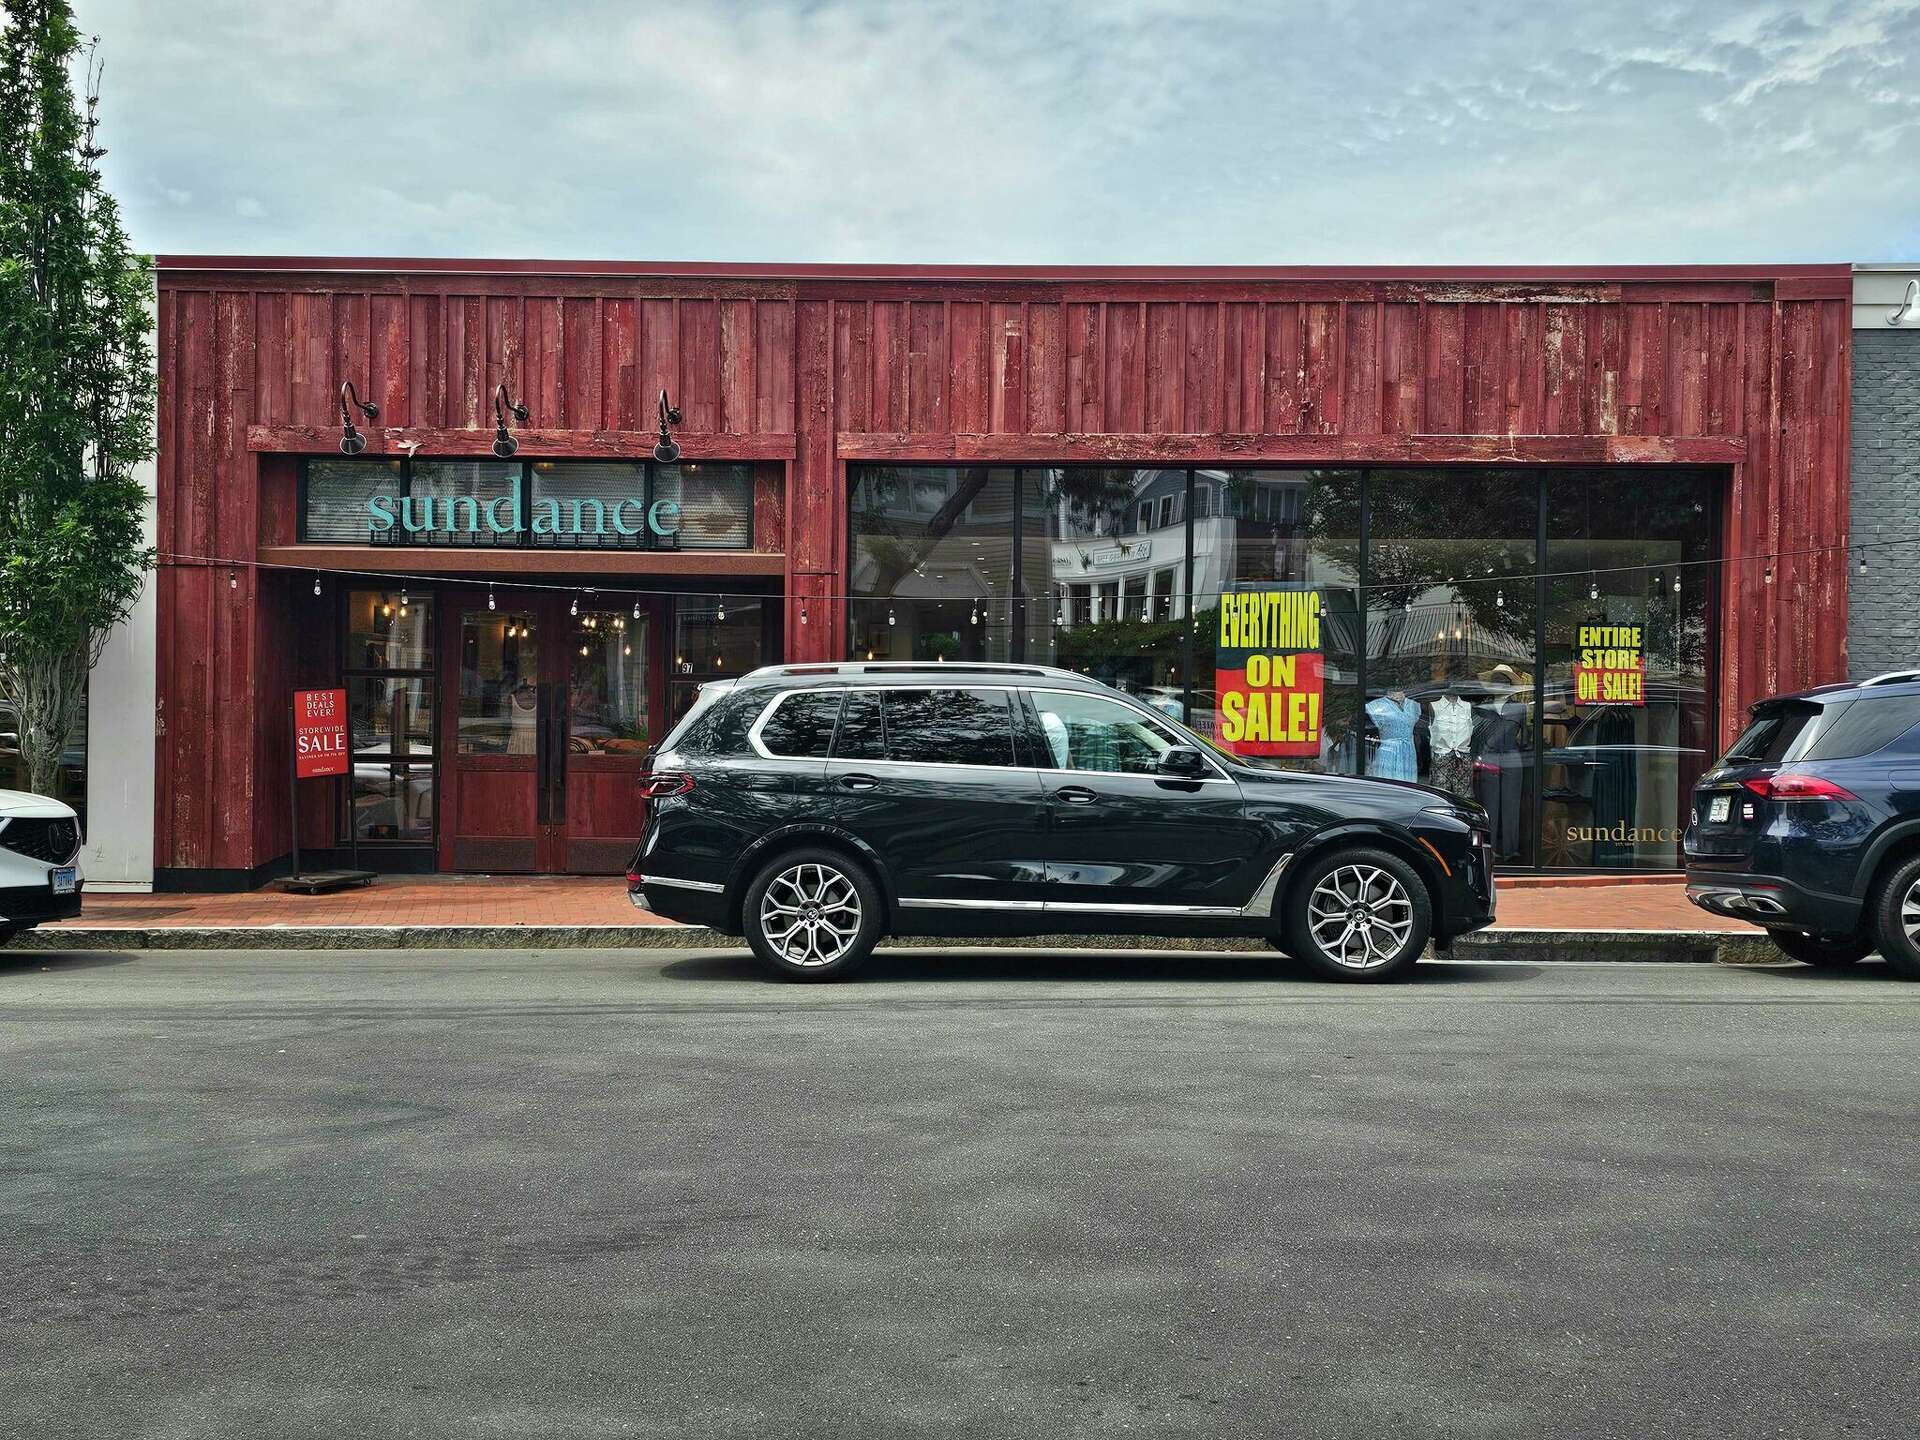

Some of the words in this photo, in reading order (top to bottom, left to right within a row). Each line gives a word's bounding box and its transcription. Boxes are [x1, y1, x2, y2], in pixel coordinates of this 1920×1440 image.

[367, 476, 680, 536] sundance
[1220, 591, 1320, 649] EVERYTHING
[1579, 626, 1642, 647] ENTIRE
[682, 662, 693, 674] 97
[1581, 649, 1640, 670] STORE
[1246, 654, 1296, 688] ON
[1578, 672, 1598, 700] ON
[1603, 672, 1642, 700] SALE!
[306, 693, 334, 701] BEST
[306, 701, 334, 709] DEALS
[307, 709, 334, 717] EVER!
[1221, 690, 1320, 742] SALE!
[299, 725, 344, 734] STOREWIDE
[298, 733, 346, 753] SALE
[1567, 819, 1683, 842] sundance
